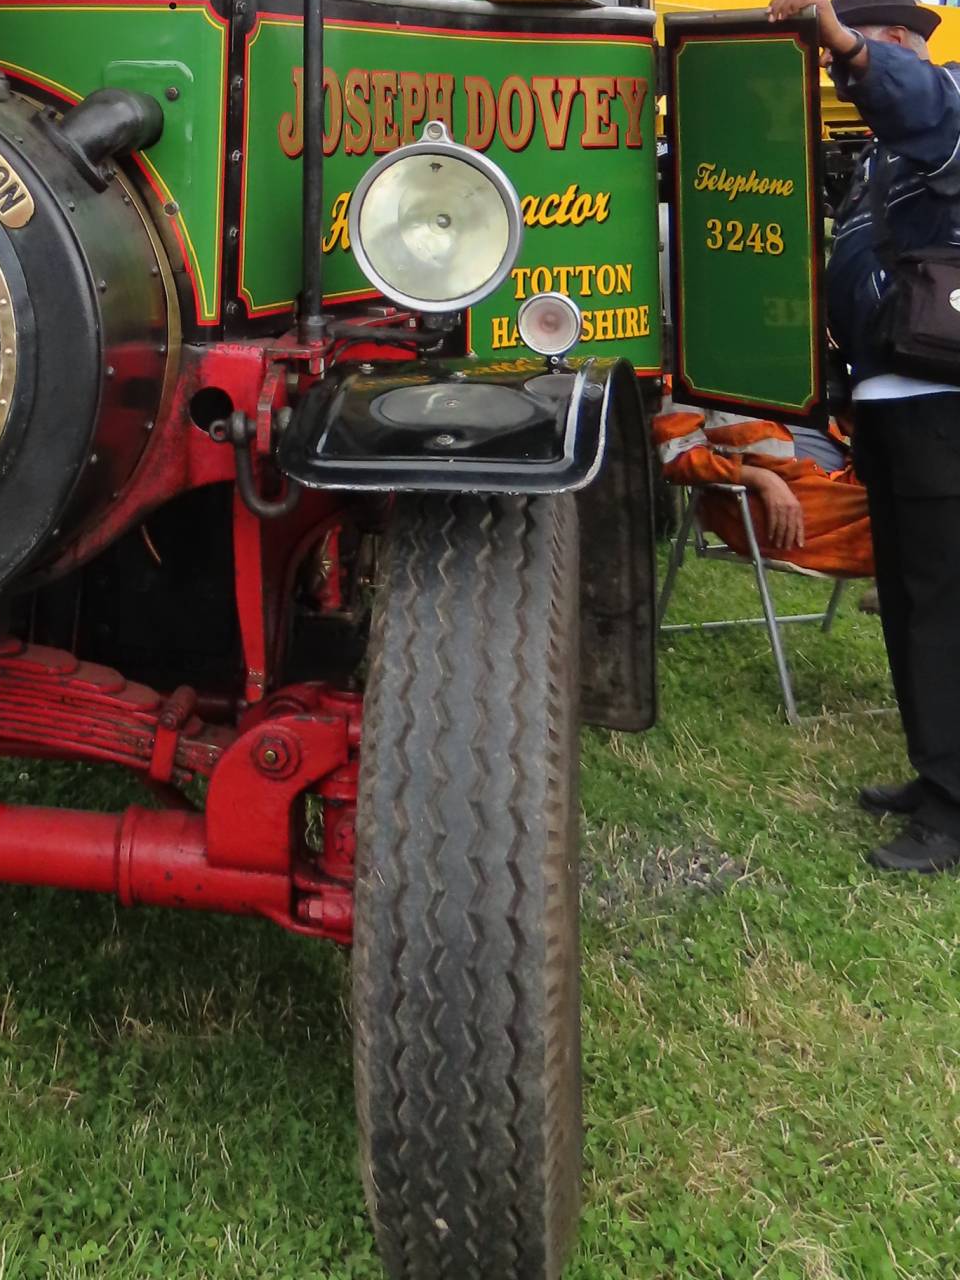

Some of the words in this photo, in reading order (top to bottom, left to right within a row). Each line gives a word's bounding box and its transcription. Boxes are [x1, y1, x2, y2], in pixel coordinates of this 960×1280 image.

[278, 66, 456, 158] JOSEPH
[464, 74, 649, 152] DOVEY
[693, 162, 795, 201] Telephone
[705, 218, 785, 256] 3248
[511, 263, 632, 300] TOTTON
[491, 305, 650, 350] HASHIRE
